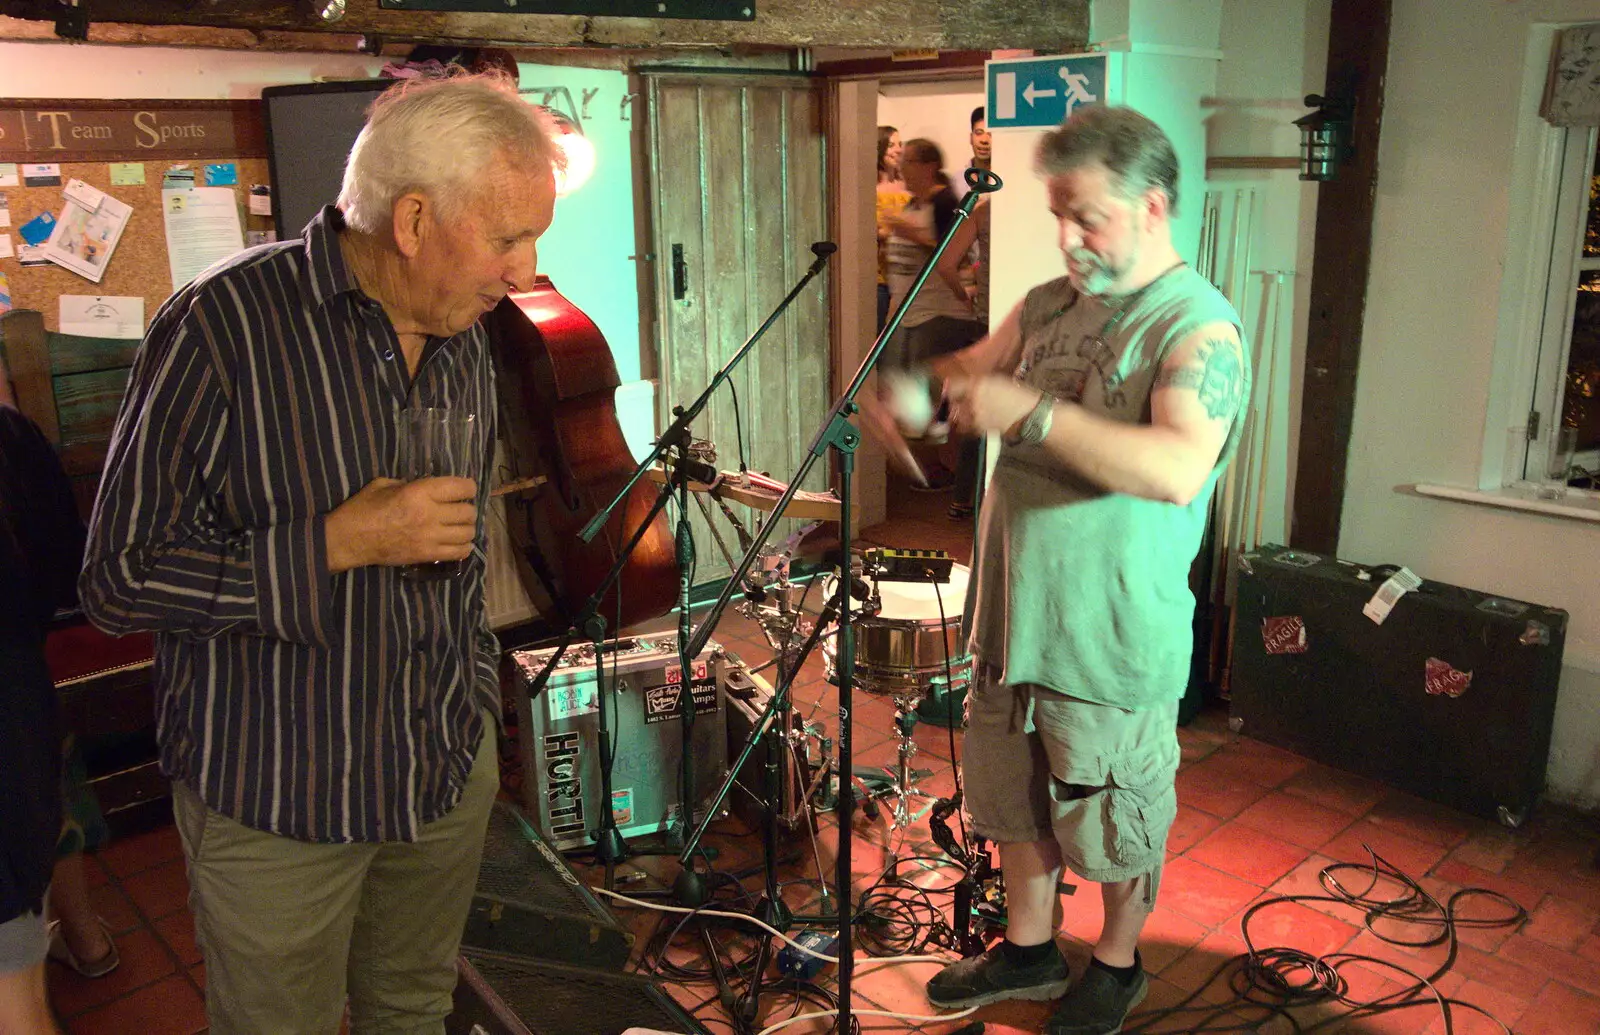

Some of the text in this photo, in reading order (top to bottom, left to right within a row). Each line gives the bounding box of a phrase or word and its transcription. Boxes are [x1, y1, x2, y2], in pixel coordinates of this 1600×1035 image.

[36, 111, 206, 149] Team Sports
[1265, 615, 1302, 655] FRAGILE
[691, 685, 716, 694] uitars
[545, 732, 585, 835] HORTI
